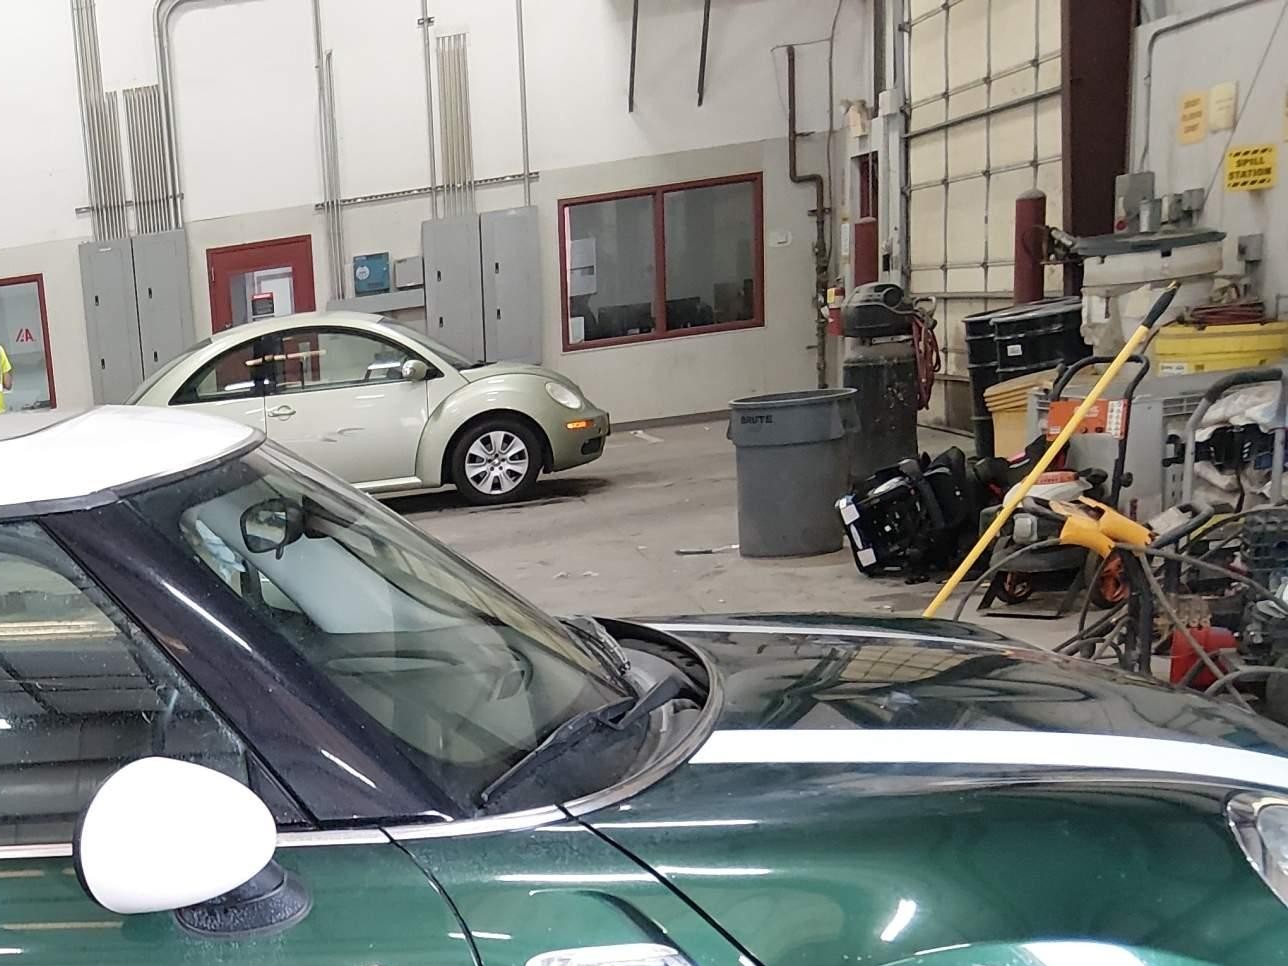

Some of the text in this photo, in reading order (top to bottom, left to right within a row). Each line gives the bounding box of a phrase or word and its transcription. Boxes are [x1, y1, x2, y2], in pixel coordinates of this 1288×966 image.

[1236, 157, 1265, 168] SPILL
[1228, 168, 1272, 181] STATION
[741, 415, 773, 424] BRUTE
